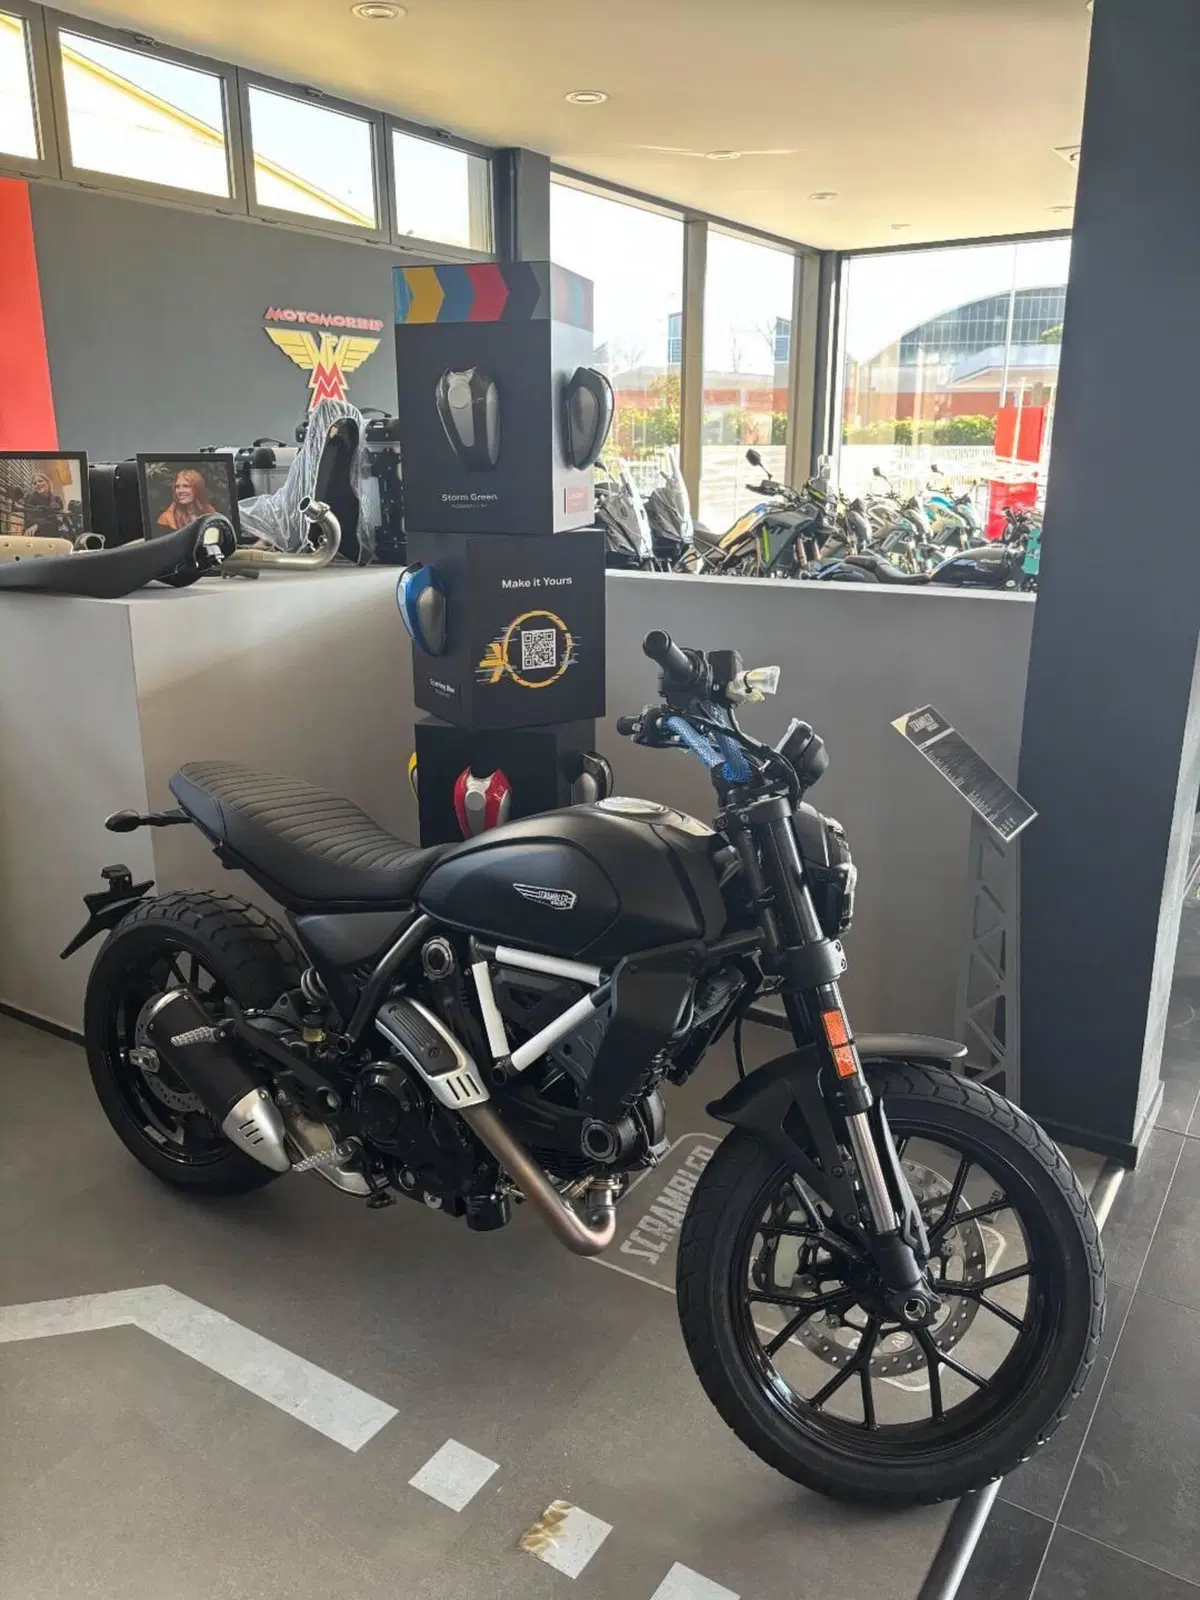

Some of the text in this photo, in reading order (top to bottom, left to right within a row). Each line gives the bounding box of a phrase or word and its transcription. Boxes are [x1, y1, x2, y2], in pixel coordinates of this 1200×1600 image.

[441, 493, 498, 502] Storm Green
[501, 576, 573, 589] Make it Yours
